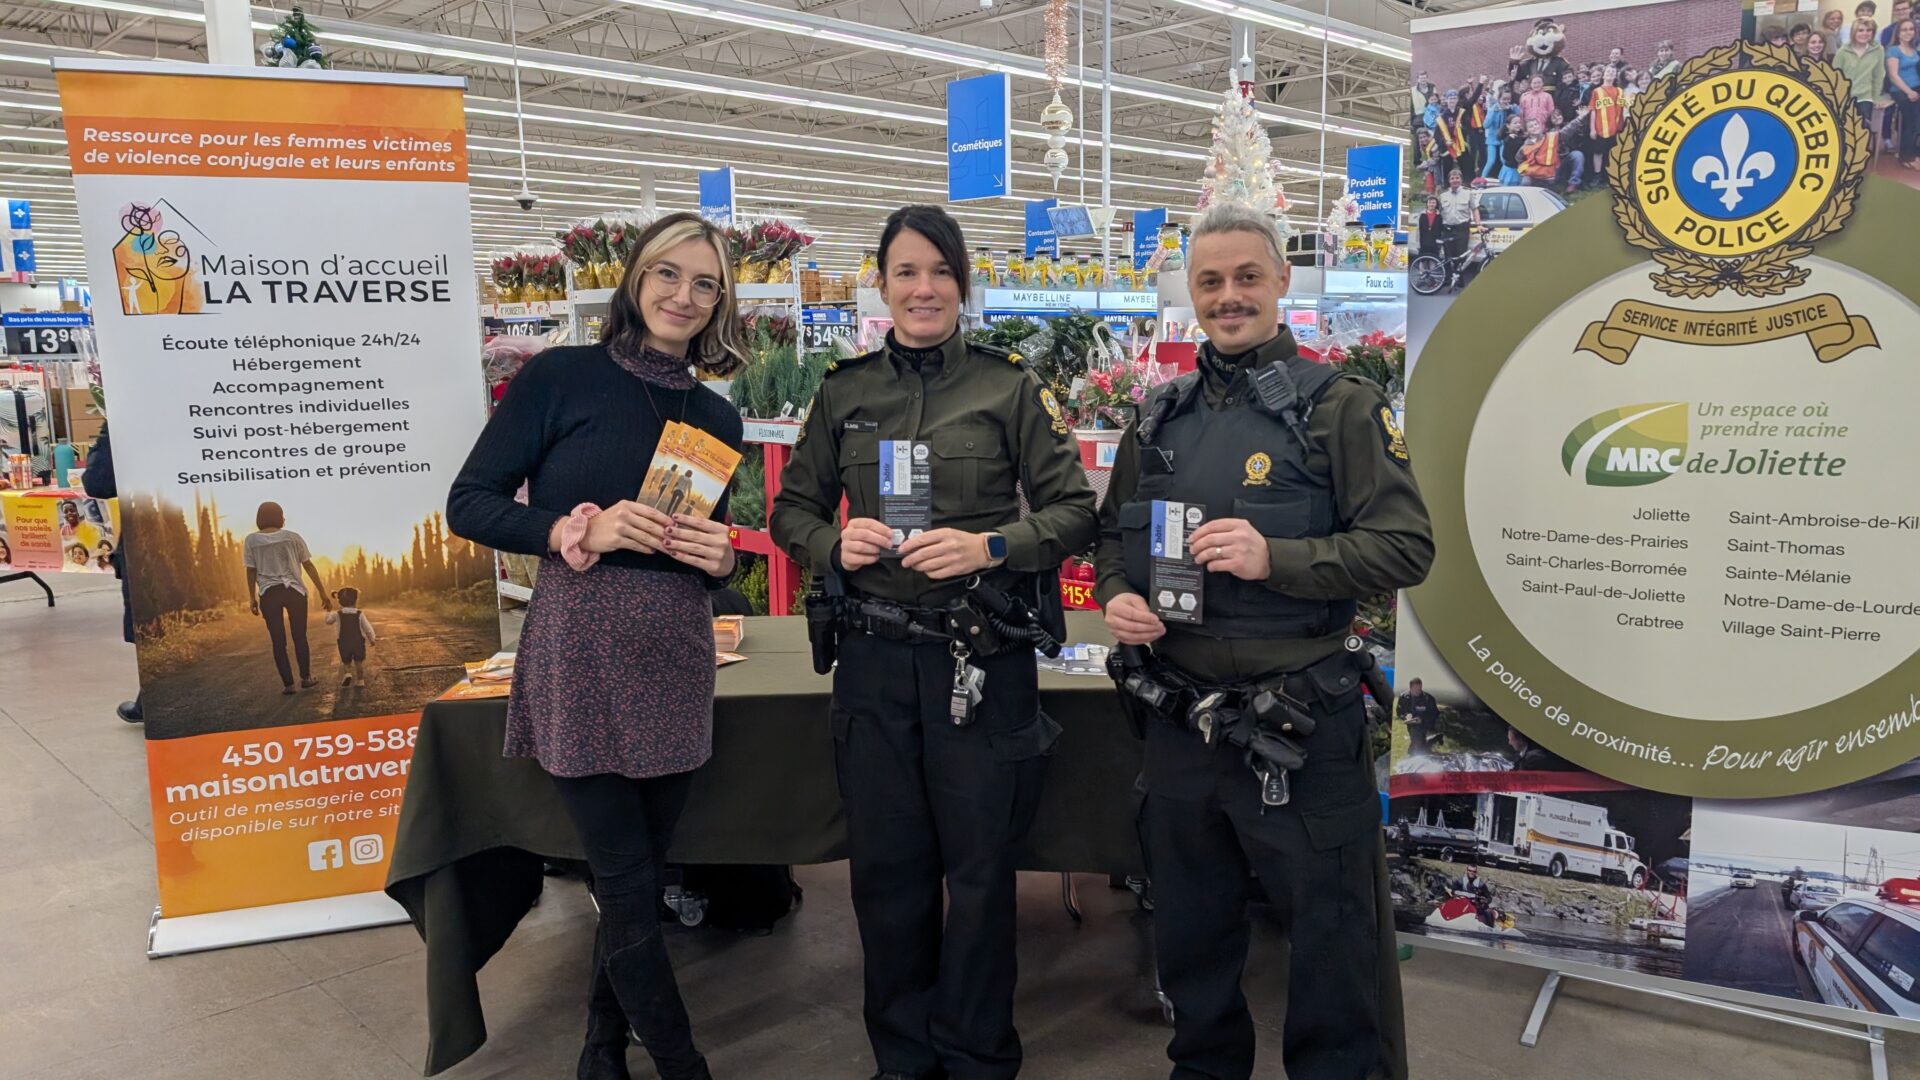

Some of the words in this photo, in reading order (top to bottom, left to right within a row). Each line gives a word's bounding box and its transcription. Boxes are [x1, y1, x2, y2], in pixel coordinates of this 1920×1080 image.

[84, 128, 192, 144] Ressource
[200, 134, 247, 147] pour
[254, 133, 281, 146] les
[288, 134, 366, 149] femmes
[373, 137, 451, 152] victimes
[952, 138, 1003, 153] Cosmétiques
[1638, 94, 1706, 205] SÛRETÉ
[1712, 79, 1755, 104] DU
[1765, 84, 1829, 193] QUÉBEC
[84, 149, 109, 163] de
[115, 149, 202, 166] violence
[207, 152, 304, 170] conjugale
[311, 156, 329, 168] et
[335, 155, 380, 169] leurs
[386, 158, 455, 171] enfants
[1350, 176, 1386, 188] Produits
[1362, 189, 1384, 199] soins
[1359, 201, 1392, 212] pillaires
[1674, 211, 1789, 248] POLICE
[202, 254, 308, 275] Maison
[321, 254, 447, 275] d'accueil
[204, 281, 251, 304] LA
[262, 280, 450, 303] TRAVERSE
[1365, 276, 1381, 288] Faux
[1382, 277, 1394, 289] cils
[1013, 293, 1071, 302] MAYBELLINE
[1622, 309, 1678, 333] SERVICE
[1684, 317, 1758, 336] INTÉGRITÉ
[1766, 304, 1828, 331] JUSTICE
[163, 335, 228, 350] Écoute
[234, 335, 355, 351] téléphonique
[361, 333, 420, 347] 24h/24
[233, 357, 361, 372] Hébergement
[1212, 355, 1237, 372] POLIC
[213, 378, 384, 395] Accompagnement
[189, 404, 293, 417] Rencontres
[300, 398, 409, 413] individuelles
[1698, 402, 1723, 416] Un
[1731, 406, 1796, 421] espace
[1803, 402, 1828, 417] où
[194, 425, 237, 439] Suivi
[245, 420, 409, 440] post-hébergement
[1701, 421, 1778, 440] prendre
[1786, 422, 1848, 437] racine
[202, 447, 308, 460] Rencontres
[315, 444, 336, 455] de
[343, 443, 405, 457] groupe
[1606, 447, 1681, 473] MRC
[1687, 453, 1718, 473] de
[1720, 449, 1846, 476] Joliette
[178, 468, 309, 484] Sensibilisation
[316, 466, 333, 476] et
[340, 462, 430, 479] prévention
[1633, 508, 1690, 521] Joliette
[1502, 528, 1688, 549] Notre-Dame-des-Prairies
[1728, 539, 1844, 555] Saint-Thomas
[1506, 553, 1686, 576] Saint-Charles-Borromée
[1726, 566, 1851, 584] Sainte-Mélanie
[1522, 580, 1685, 602] Saint-Paul-de-Joliette
[1617, 613, 1683, 629] Crabtree
[1722, 621, 1775, 637] Village
[1781, 624, 1880, 641] Saint-Pierre
[1468, 635, 1490, 662] La
[1487, 659, 1541, 709] police
[1545, 706, 1569, 725] de
[1702, 745, 1772, 770] Pour
[1776, 740, 1828, 771] agir
[222, 742, 283, 767] 450
[170, 807, 218, 826] Outil
[225, 804, 248, 817] de
[255, 789, 364, 815] messagerie
[370, 788, 404, 800] con
[181, 818, 283, 842] disponible
[289, 816, 318, 828] sur
[325, 809, 373, 823] notre
